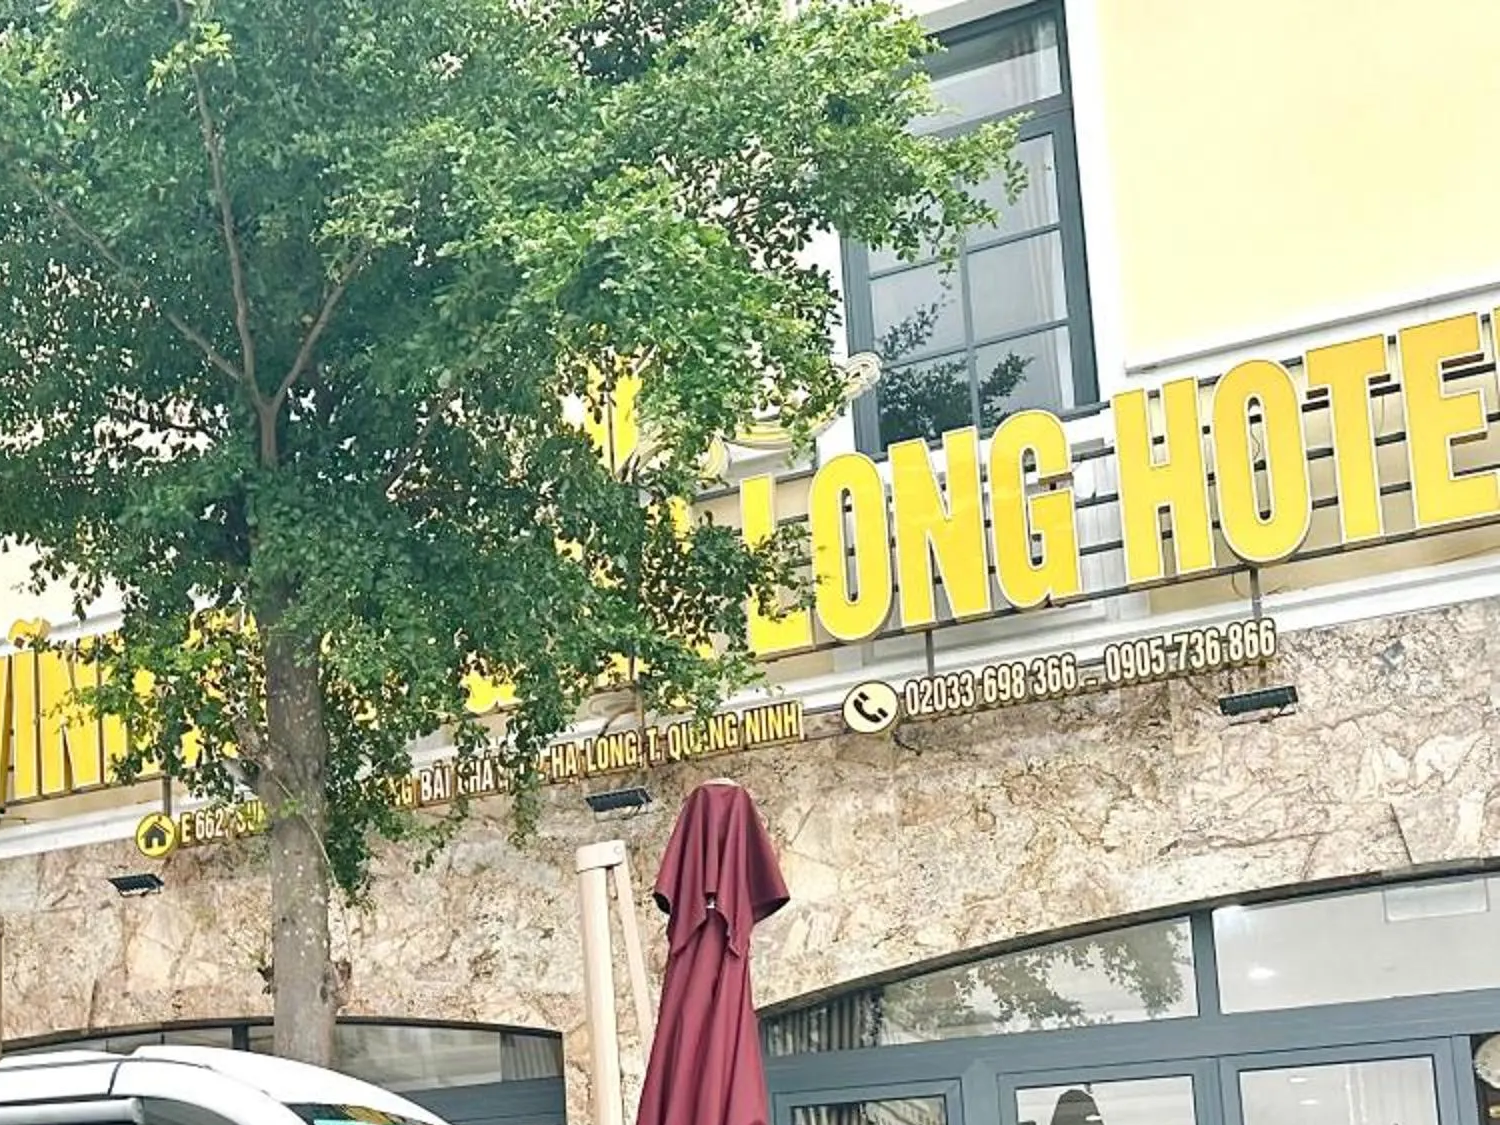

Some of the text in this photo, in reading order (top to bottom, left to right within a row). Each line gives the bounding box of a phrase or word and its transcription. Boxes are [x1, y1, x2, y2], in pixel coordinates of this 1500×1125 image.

[740, 409, 1082, 657] LONG
[1112, 306, 1500, 586] HOTE
[904, 679, 975, 716] 02033
[981, 661, 1027, 703] 698
[1031, 652, 1078, 695] 366
[1104, 638, 1166, 684] 0905
[1172, 627, 1221, 672] 736
[1226, 617, 1277, 662] 866
[181, 813, 192, 843] E
[645, 725, 662, 761] T.
[743, 701, 799, 745] NINH
